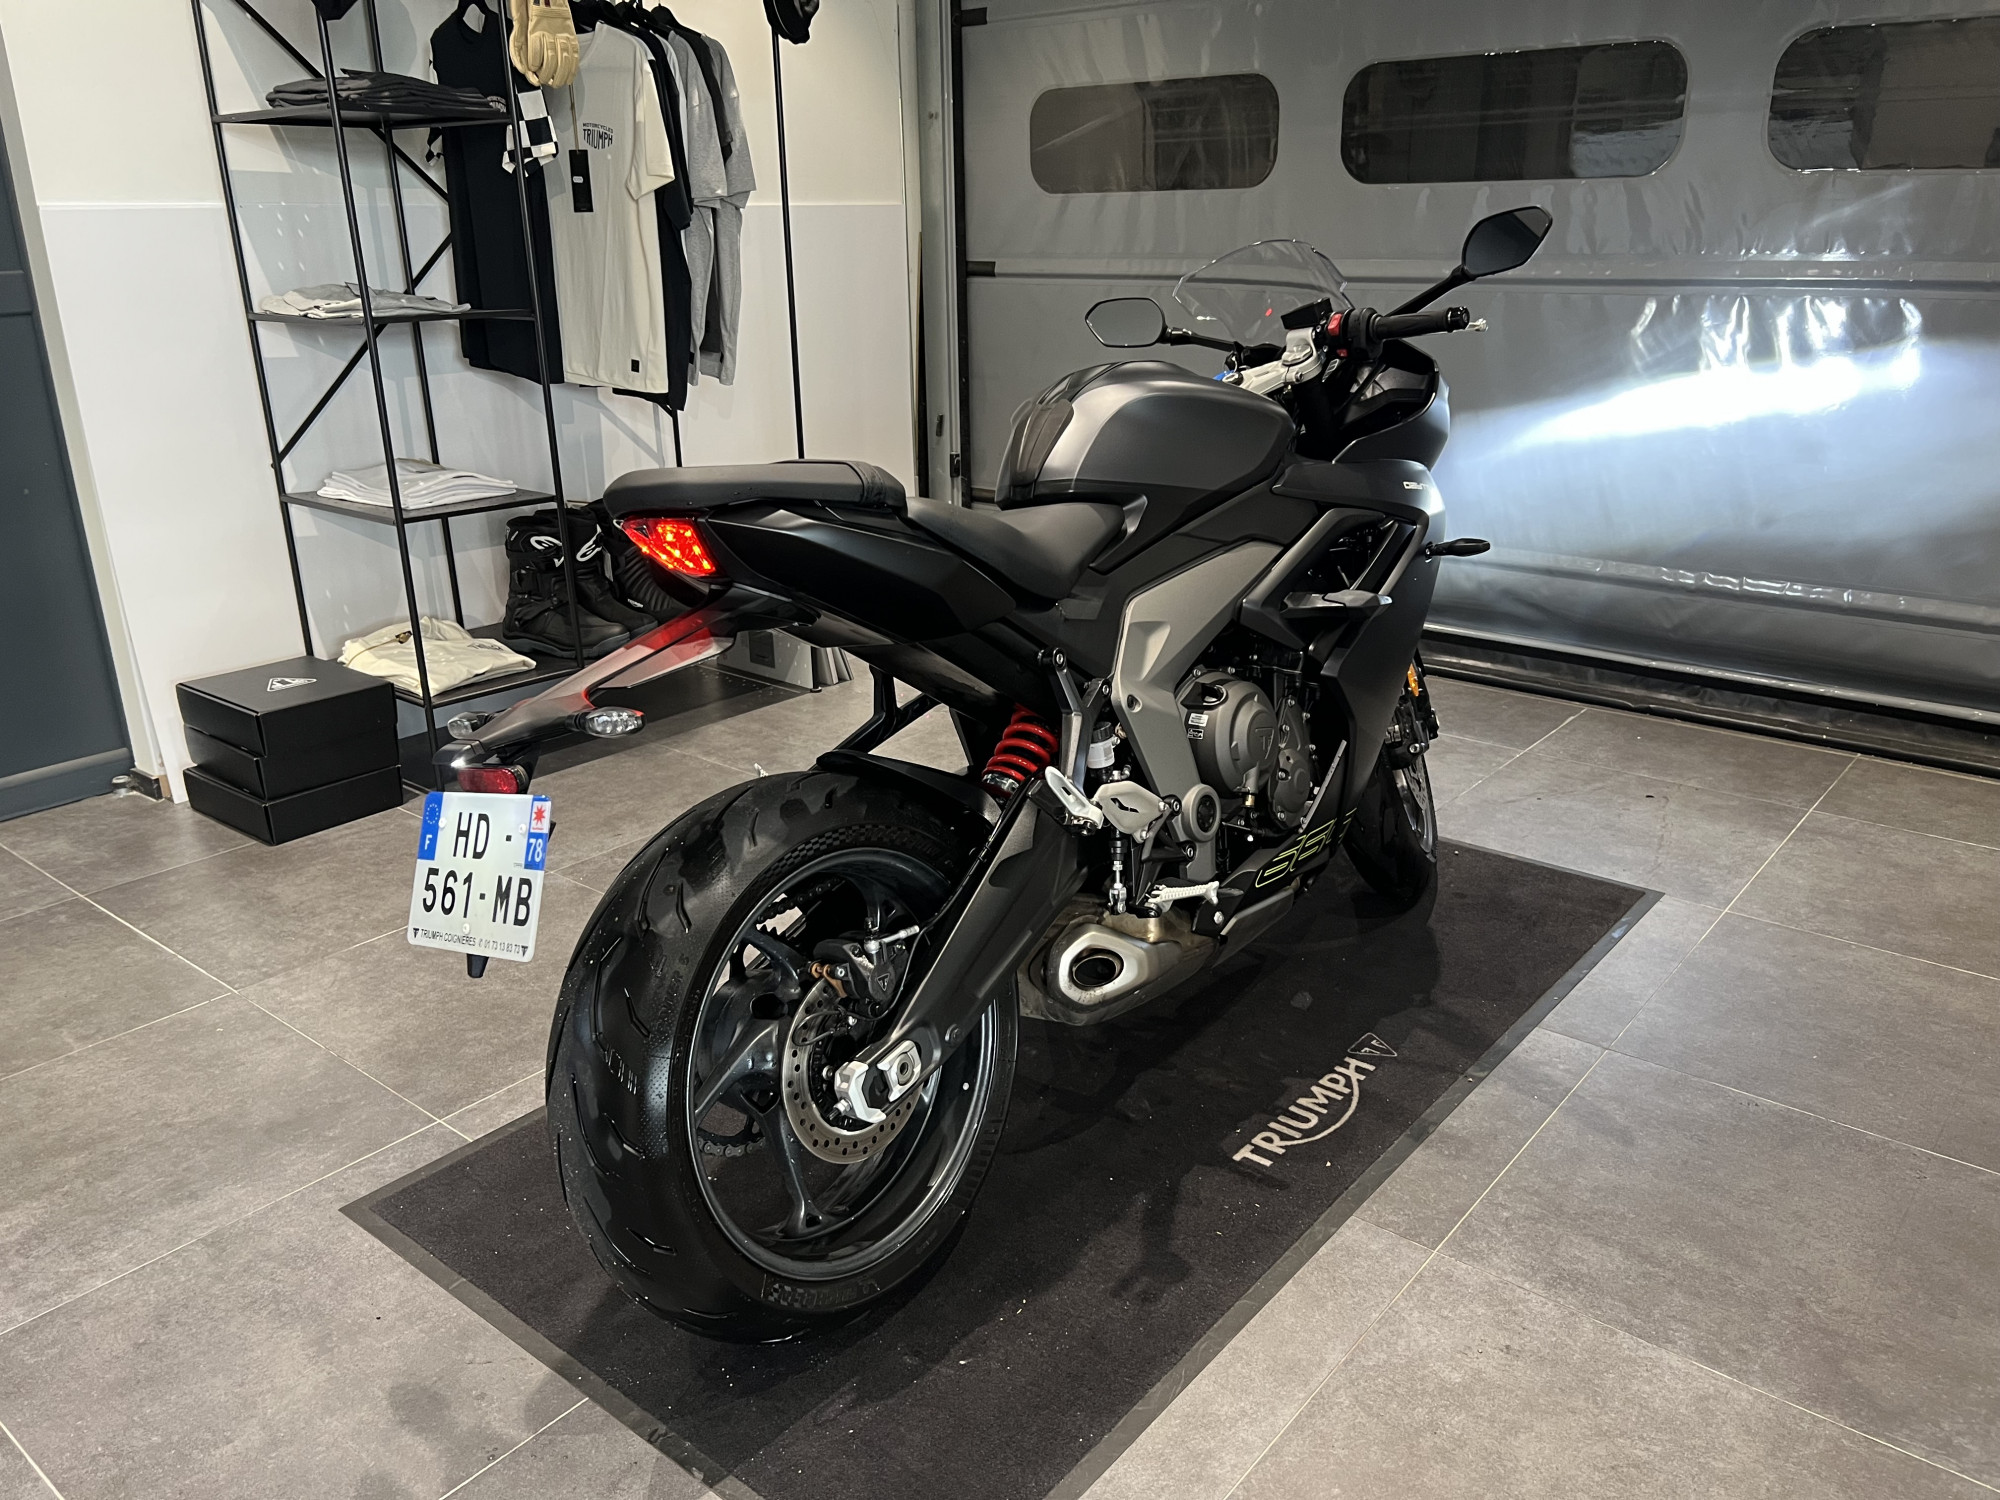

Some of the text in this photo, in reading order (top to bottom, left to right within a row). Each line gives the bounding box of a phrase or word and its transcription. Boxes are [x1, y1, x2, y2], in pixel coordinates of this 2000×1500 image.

[583, 123, 614, 134] MOTORCYCLES
[583, 129, 613, 150] TRIUMPH
[424, 834, 433, 850] F
[453, 811, 490, 860] HD
[528, 837, 544, 863] 78
[422, 867, 533, 927] 561-MB
[421, 928, 443, 941] TRIUMPH
[1232, 1057, 1376, 1167] TRIUMPH
